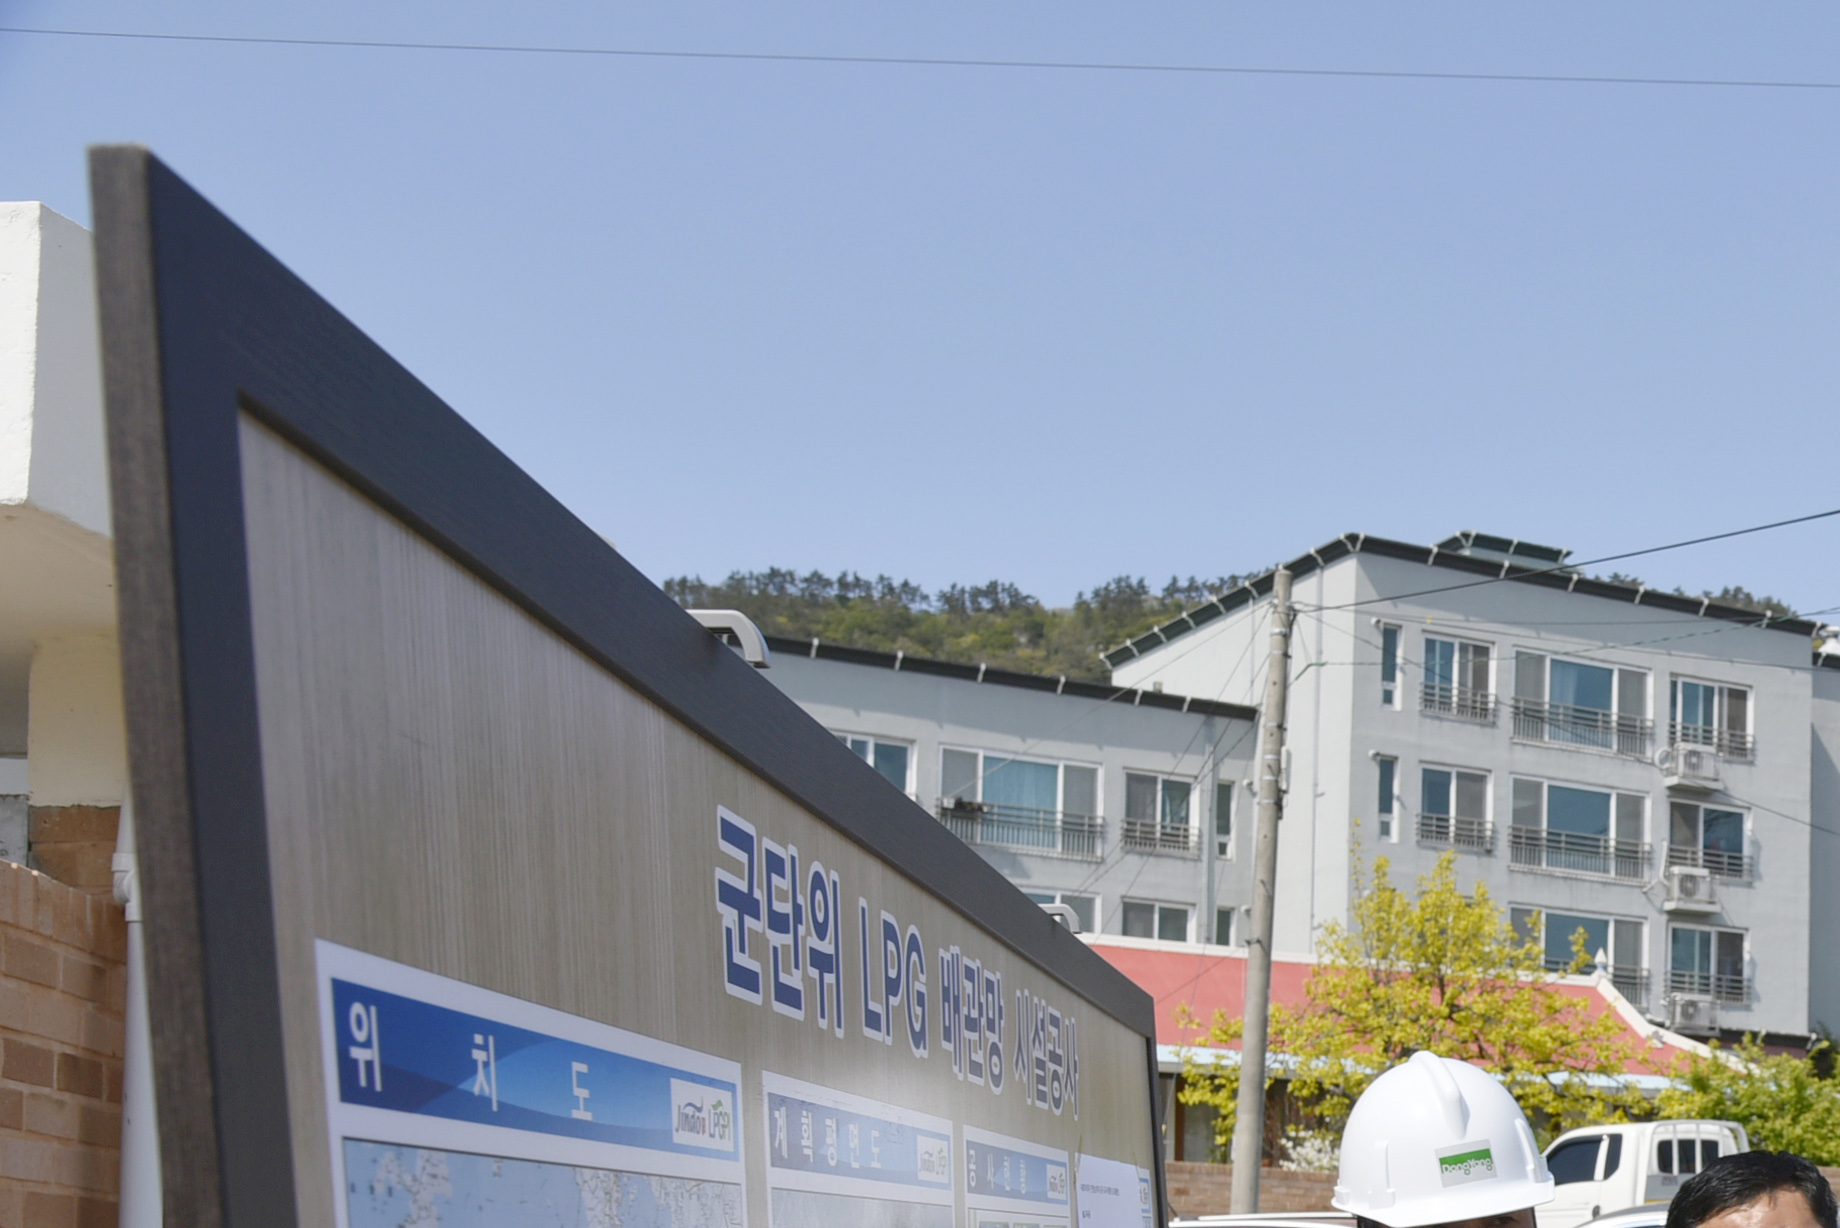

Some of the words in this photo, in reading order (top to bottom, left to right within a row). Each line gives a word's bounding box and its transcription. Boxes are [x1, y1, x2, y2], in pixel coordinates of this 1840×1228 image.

[715, 804, 844, 1039] 군단위
[859, 897, 929, 1059] LPG
[939, 945, 1004, 1095] 배관망
[1013, 989, 1079, 1121] 시설공사
